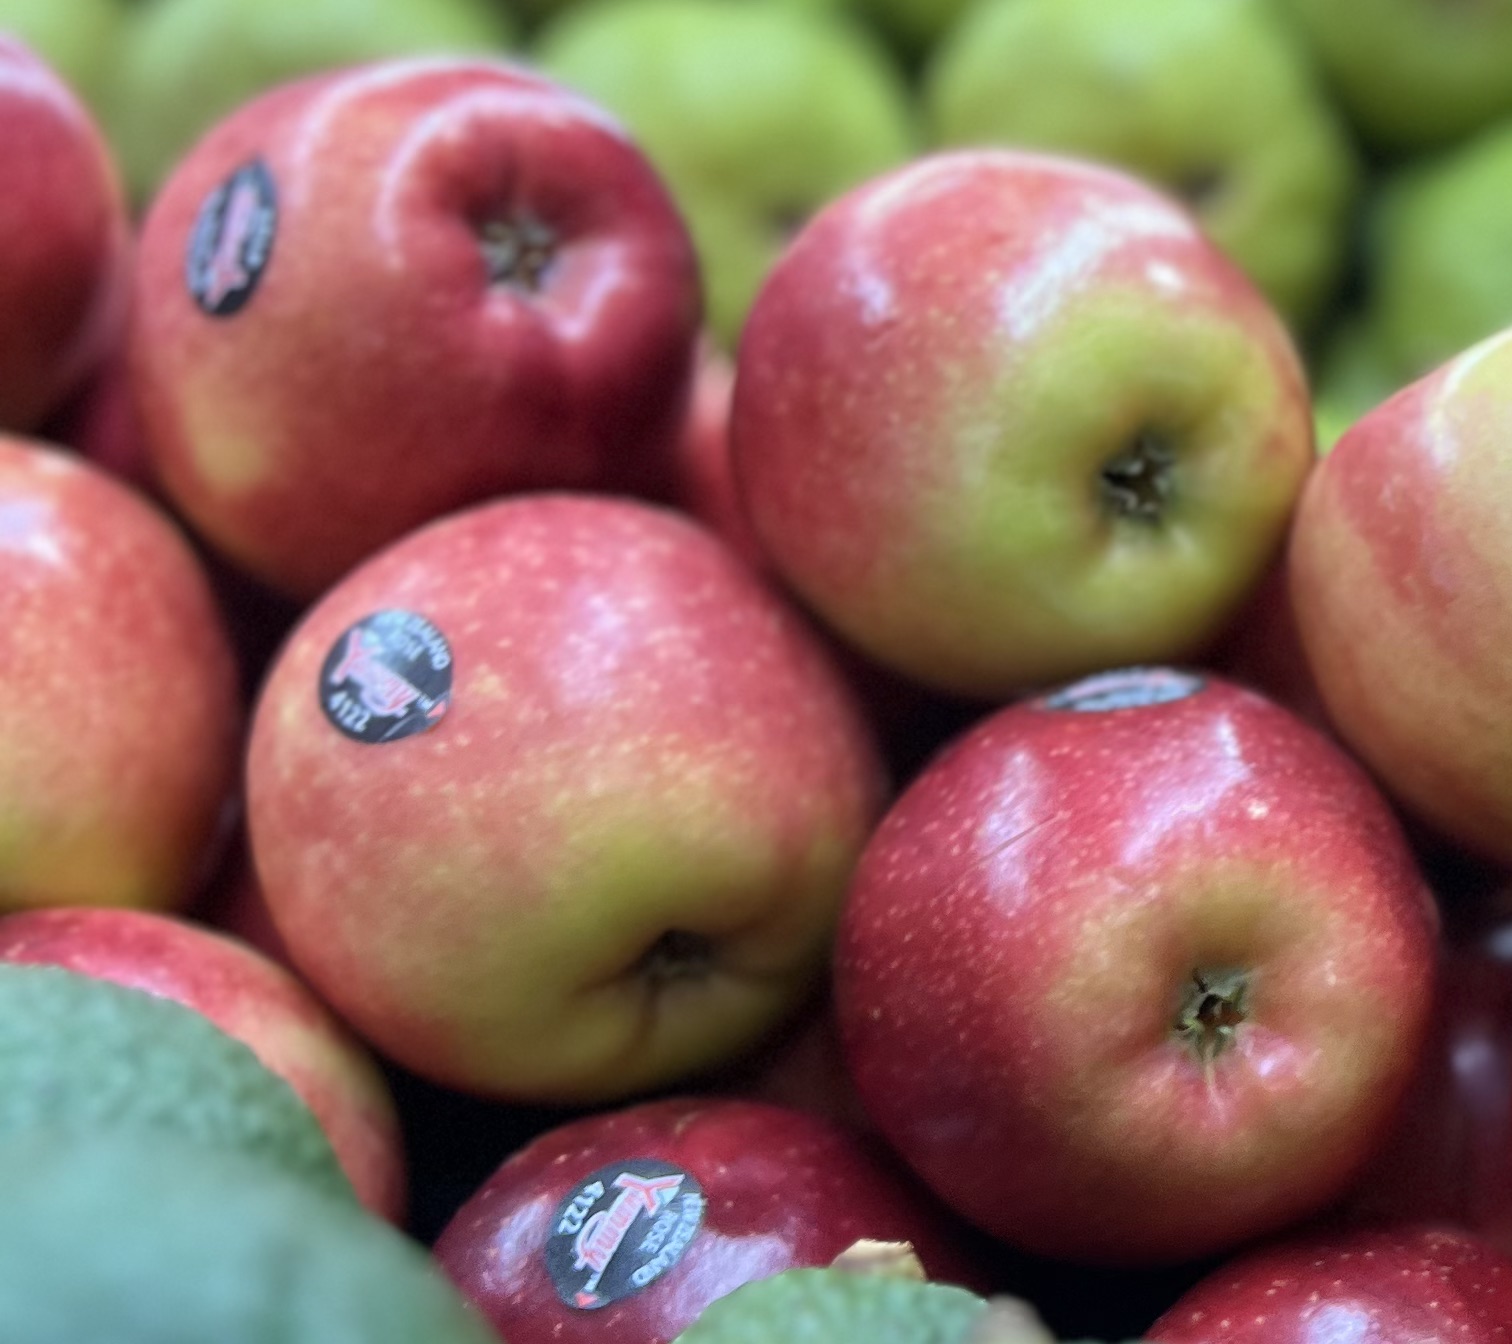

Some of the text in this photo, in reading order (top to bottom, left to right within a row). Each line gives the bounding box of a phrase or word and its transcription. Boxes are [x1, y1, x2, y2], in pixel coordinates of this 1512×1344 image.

[328, 690, 372, 733] 4122
[557, 1180, 604, 1235] 4122
[572, 1172, 685, 1273] Yummy
